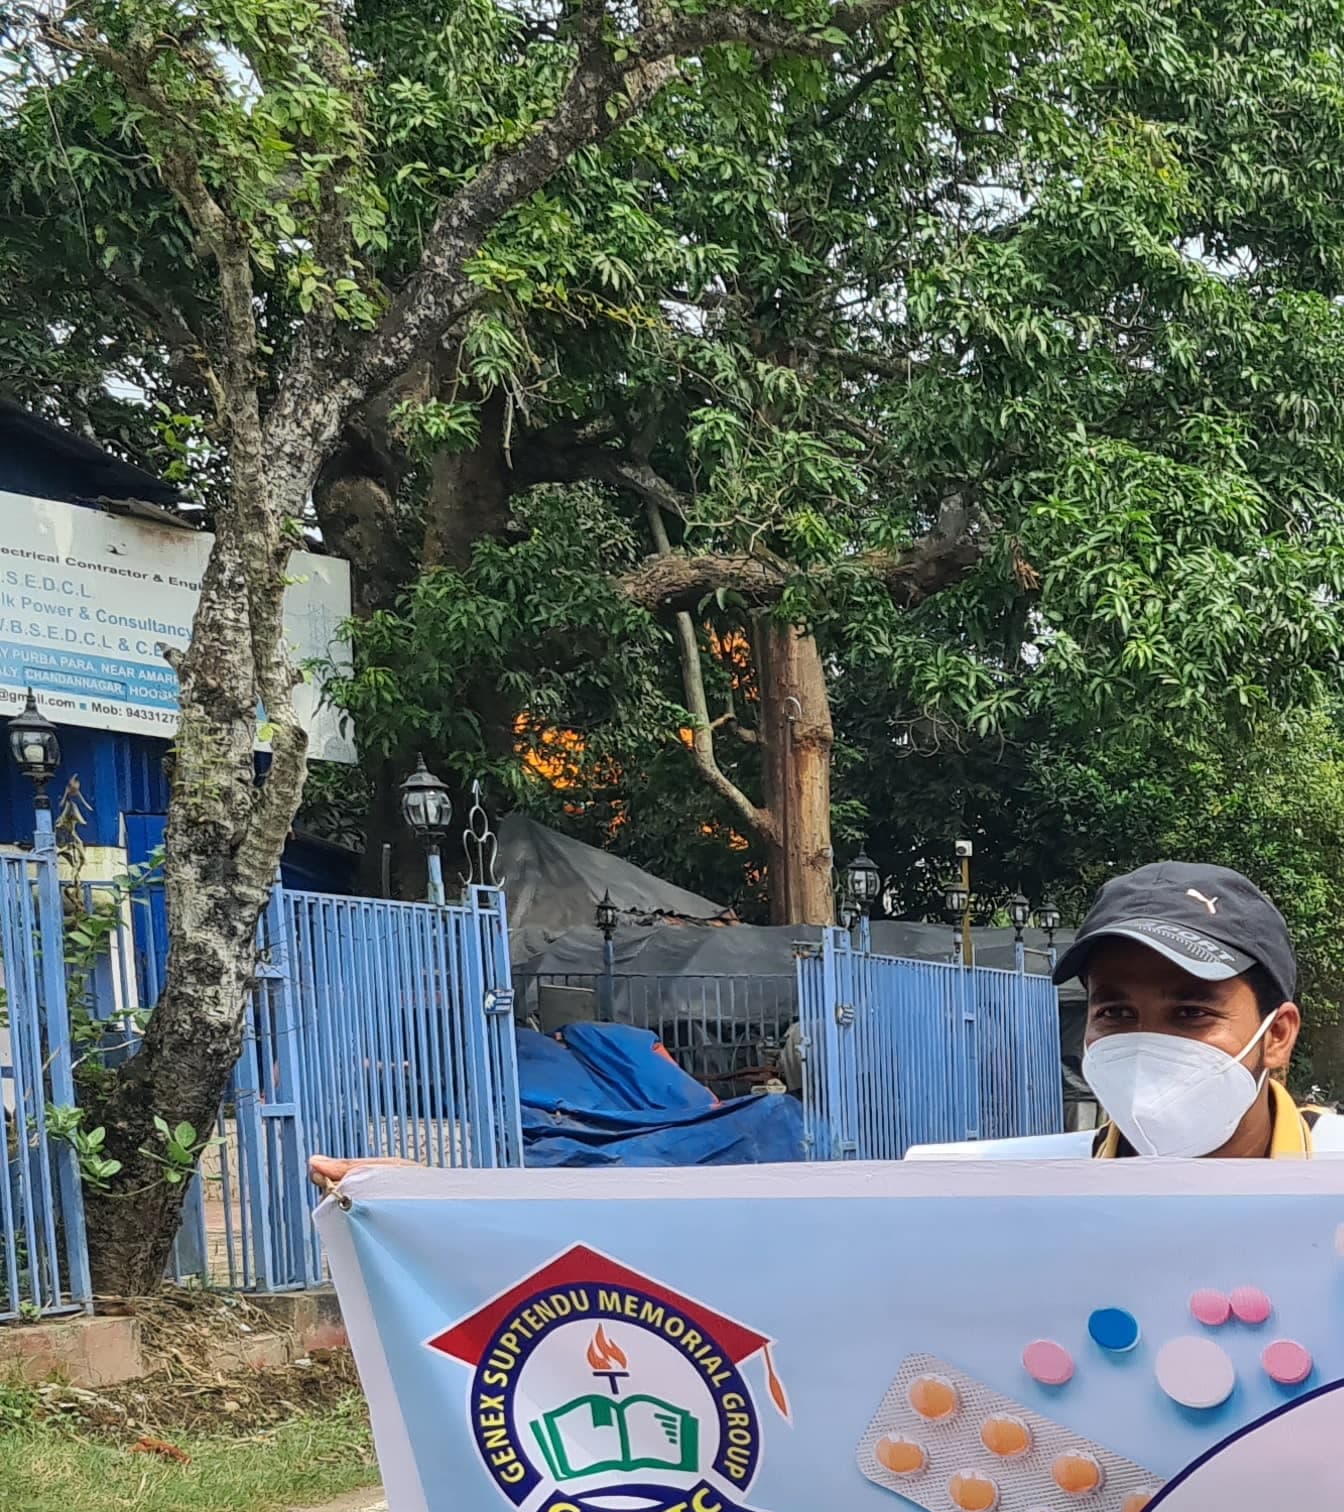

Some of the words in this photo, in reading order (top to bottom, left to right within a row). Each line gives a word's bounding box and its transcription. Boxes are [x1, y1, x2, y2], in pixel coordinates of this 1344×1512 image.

[65, 557, 149, 580] Contractor
[153, 574, 164, 583] &
[21, 596, 74, 617] Power
[79, 606, 91, 621] &
[96, 608, 193, 641] Consultancy
[12, 650, 57, 665] PURBA
[101, 663, 135, 679] NEAR
[118, 637, 130, 652] &
[91, 702, 123, 717] Mob:
[484, 1289, 591, 1388] SUPTENDU
[598, 1289, 732, 1389] MEMORIAL
[479, 1392, 526, 1485] GENEX
[721, 1392, 751, 1480] GROUP
